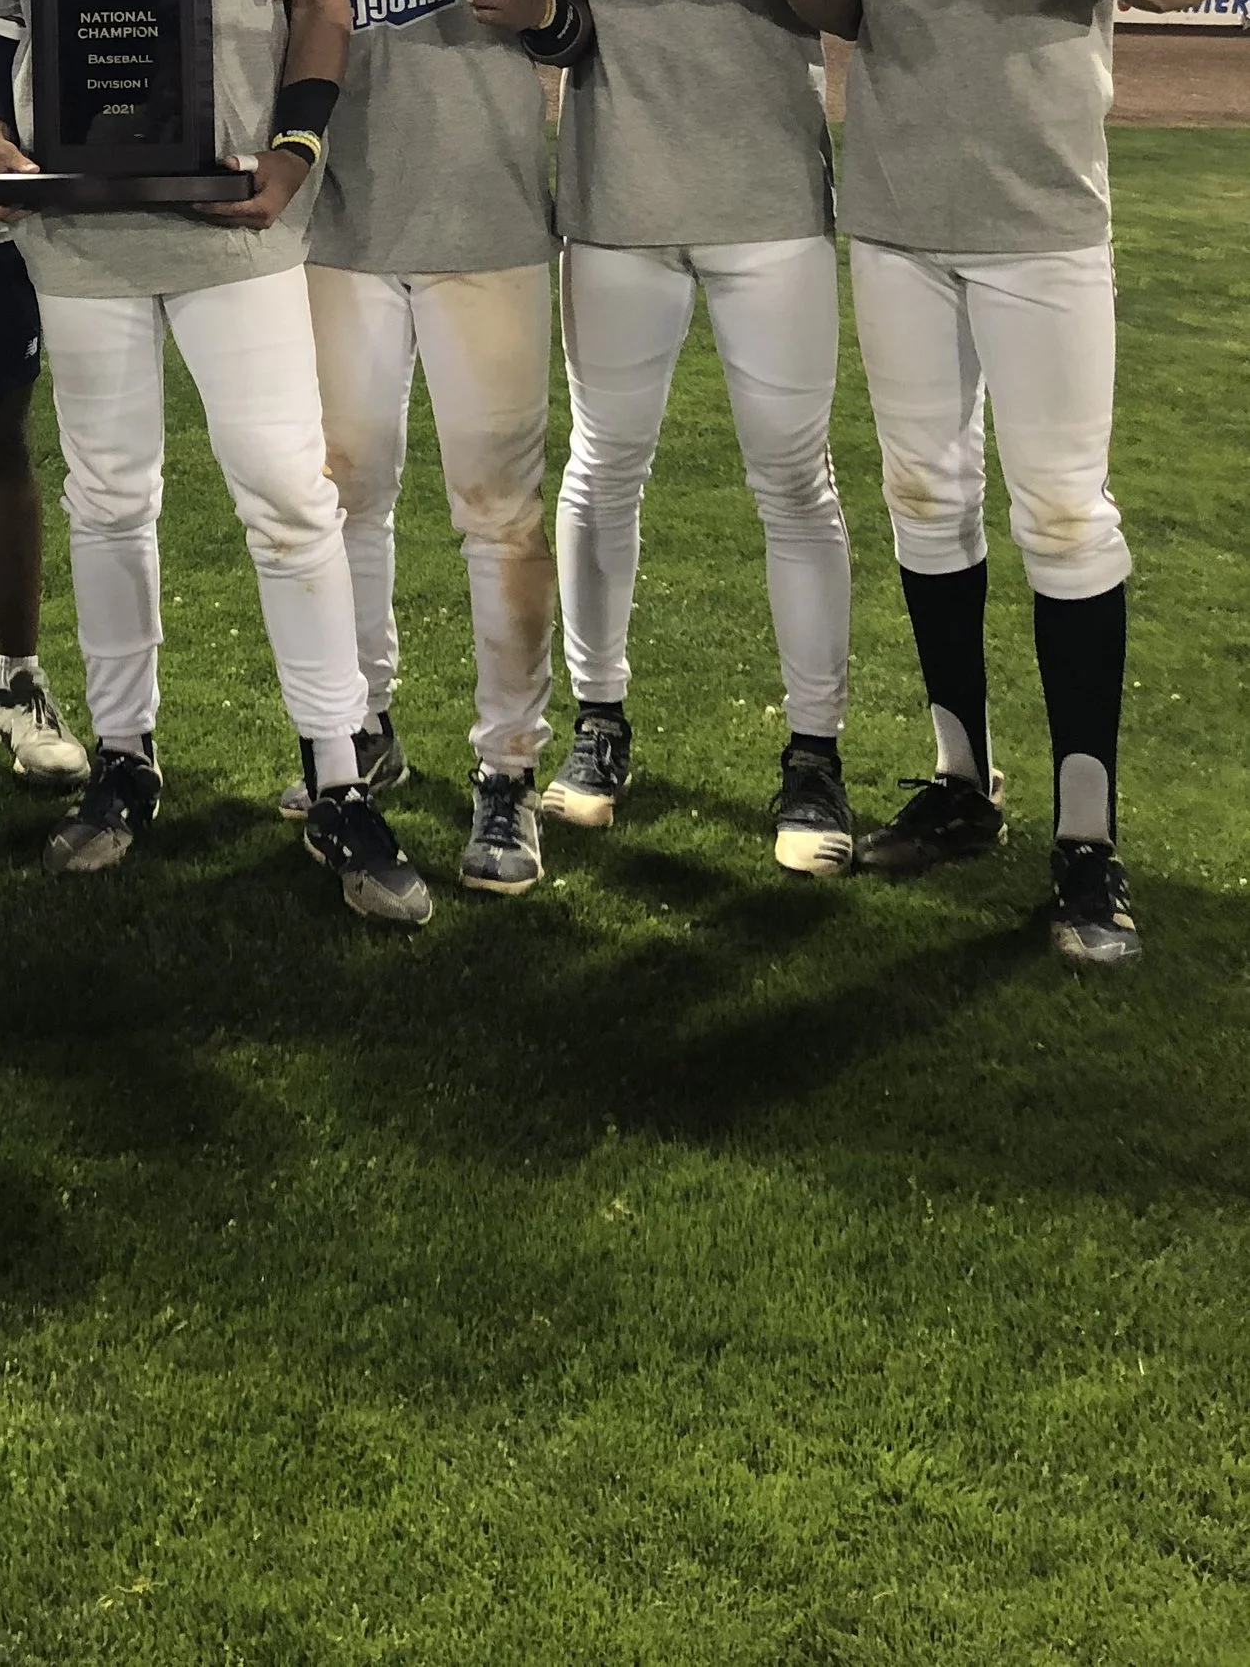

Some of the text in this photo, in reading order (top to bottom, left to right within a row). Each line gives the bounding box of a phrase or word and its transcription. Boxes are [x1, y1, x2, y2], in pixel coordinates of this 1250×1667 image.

[80, 11, 157, 24] NATIONAL
[77, 26, 159, 40] CHAMPION
[102, 103, 135, 115] 2021
